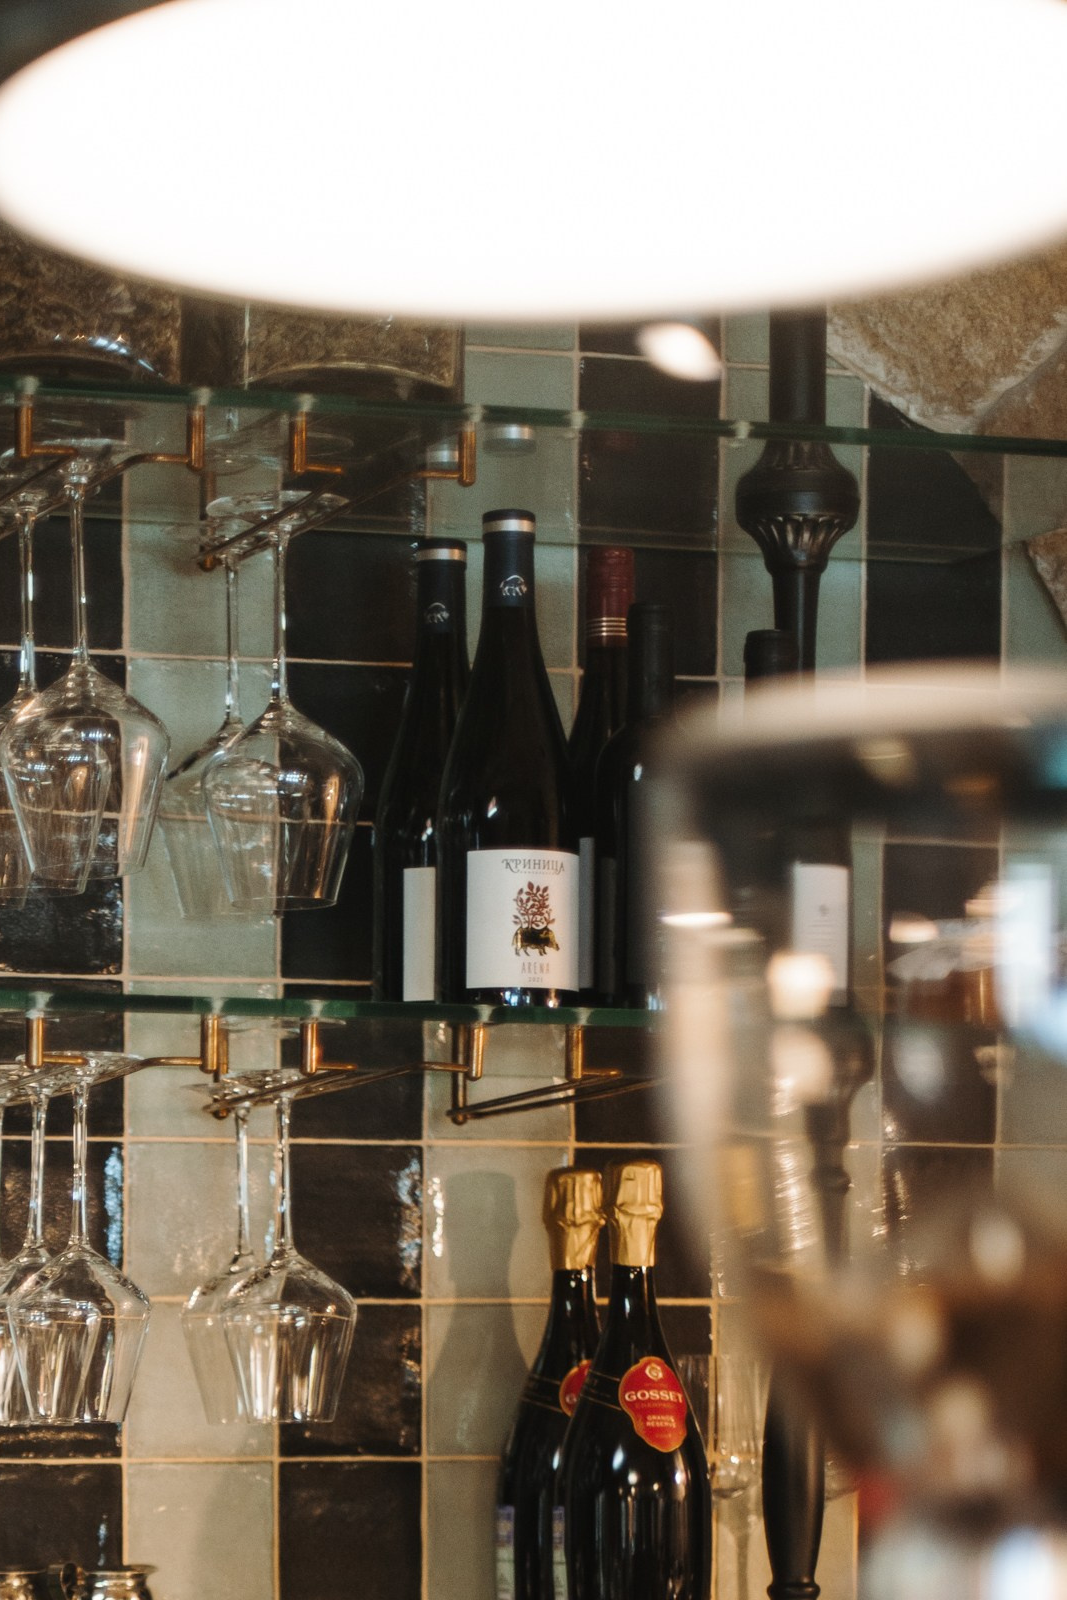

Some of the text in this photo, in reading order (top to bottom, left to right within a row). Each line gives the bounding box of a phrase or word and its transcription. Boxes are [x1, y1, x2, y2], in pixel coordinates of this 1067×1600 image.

[501, 858, 565, 875] КРИНИЦА
[521, 961, 550, 975] ARENA
[624, 1389, 683, 1404] GOSSET
